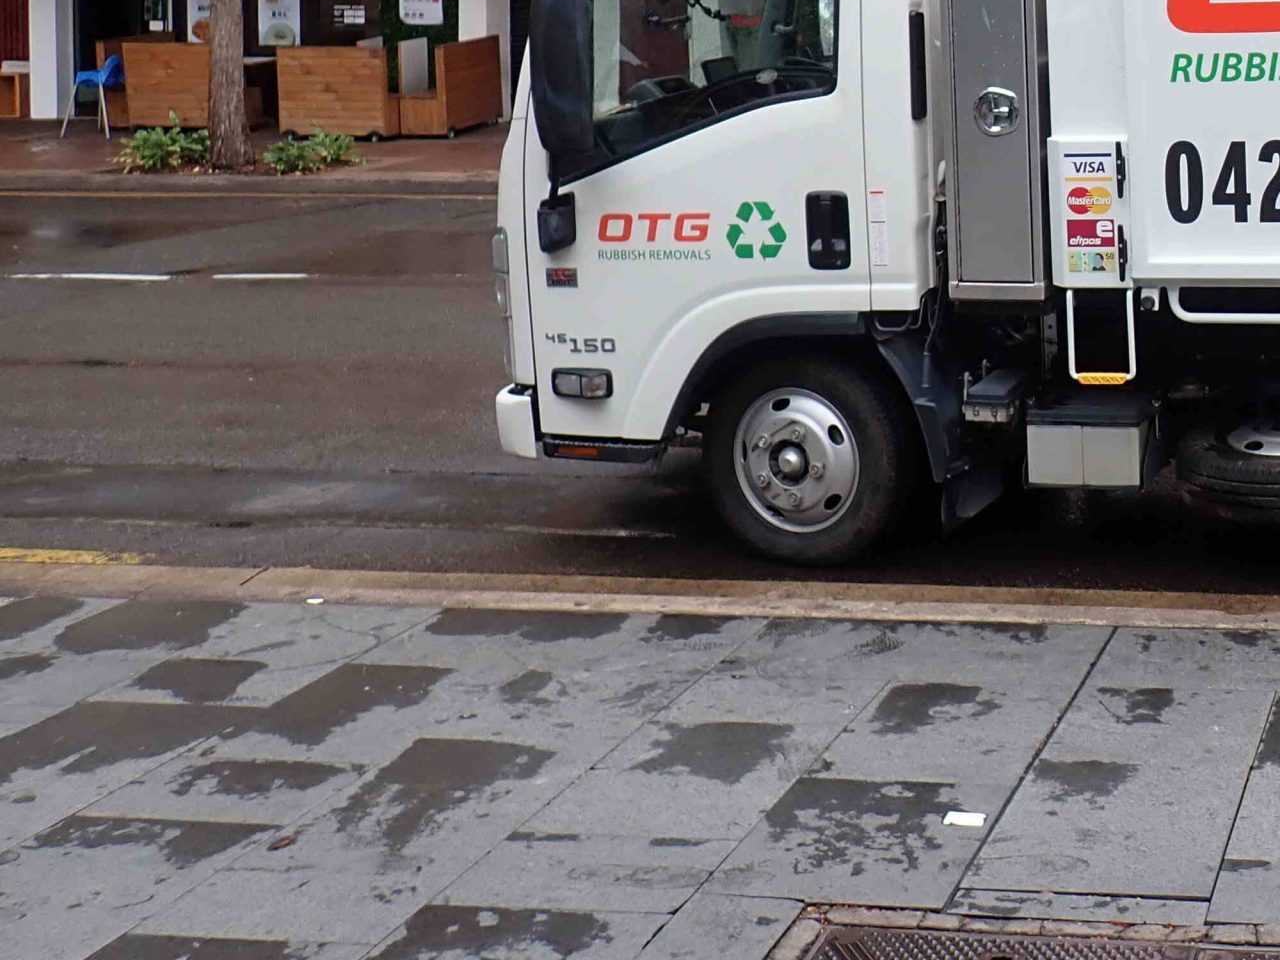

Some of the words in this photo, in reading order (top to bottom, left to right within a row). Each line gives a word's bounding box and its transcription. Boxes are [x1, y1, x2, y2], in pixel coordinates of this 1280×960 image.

[1072, 161, 1106, 174] VISA
[1067, 195, 1112, 206] MasterCard
[598, 212, 710, 242] OTG
[1069, 236, 1102, 246] eftpos
[598, 249, 646, 261] RUBBISH
[648, 249, 712, 261] REMOVALS
[569, 337, 616, 353] 150
